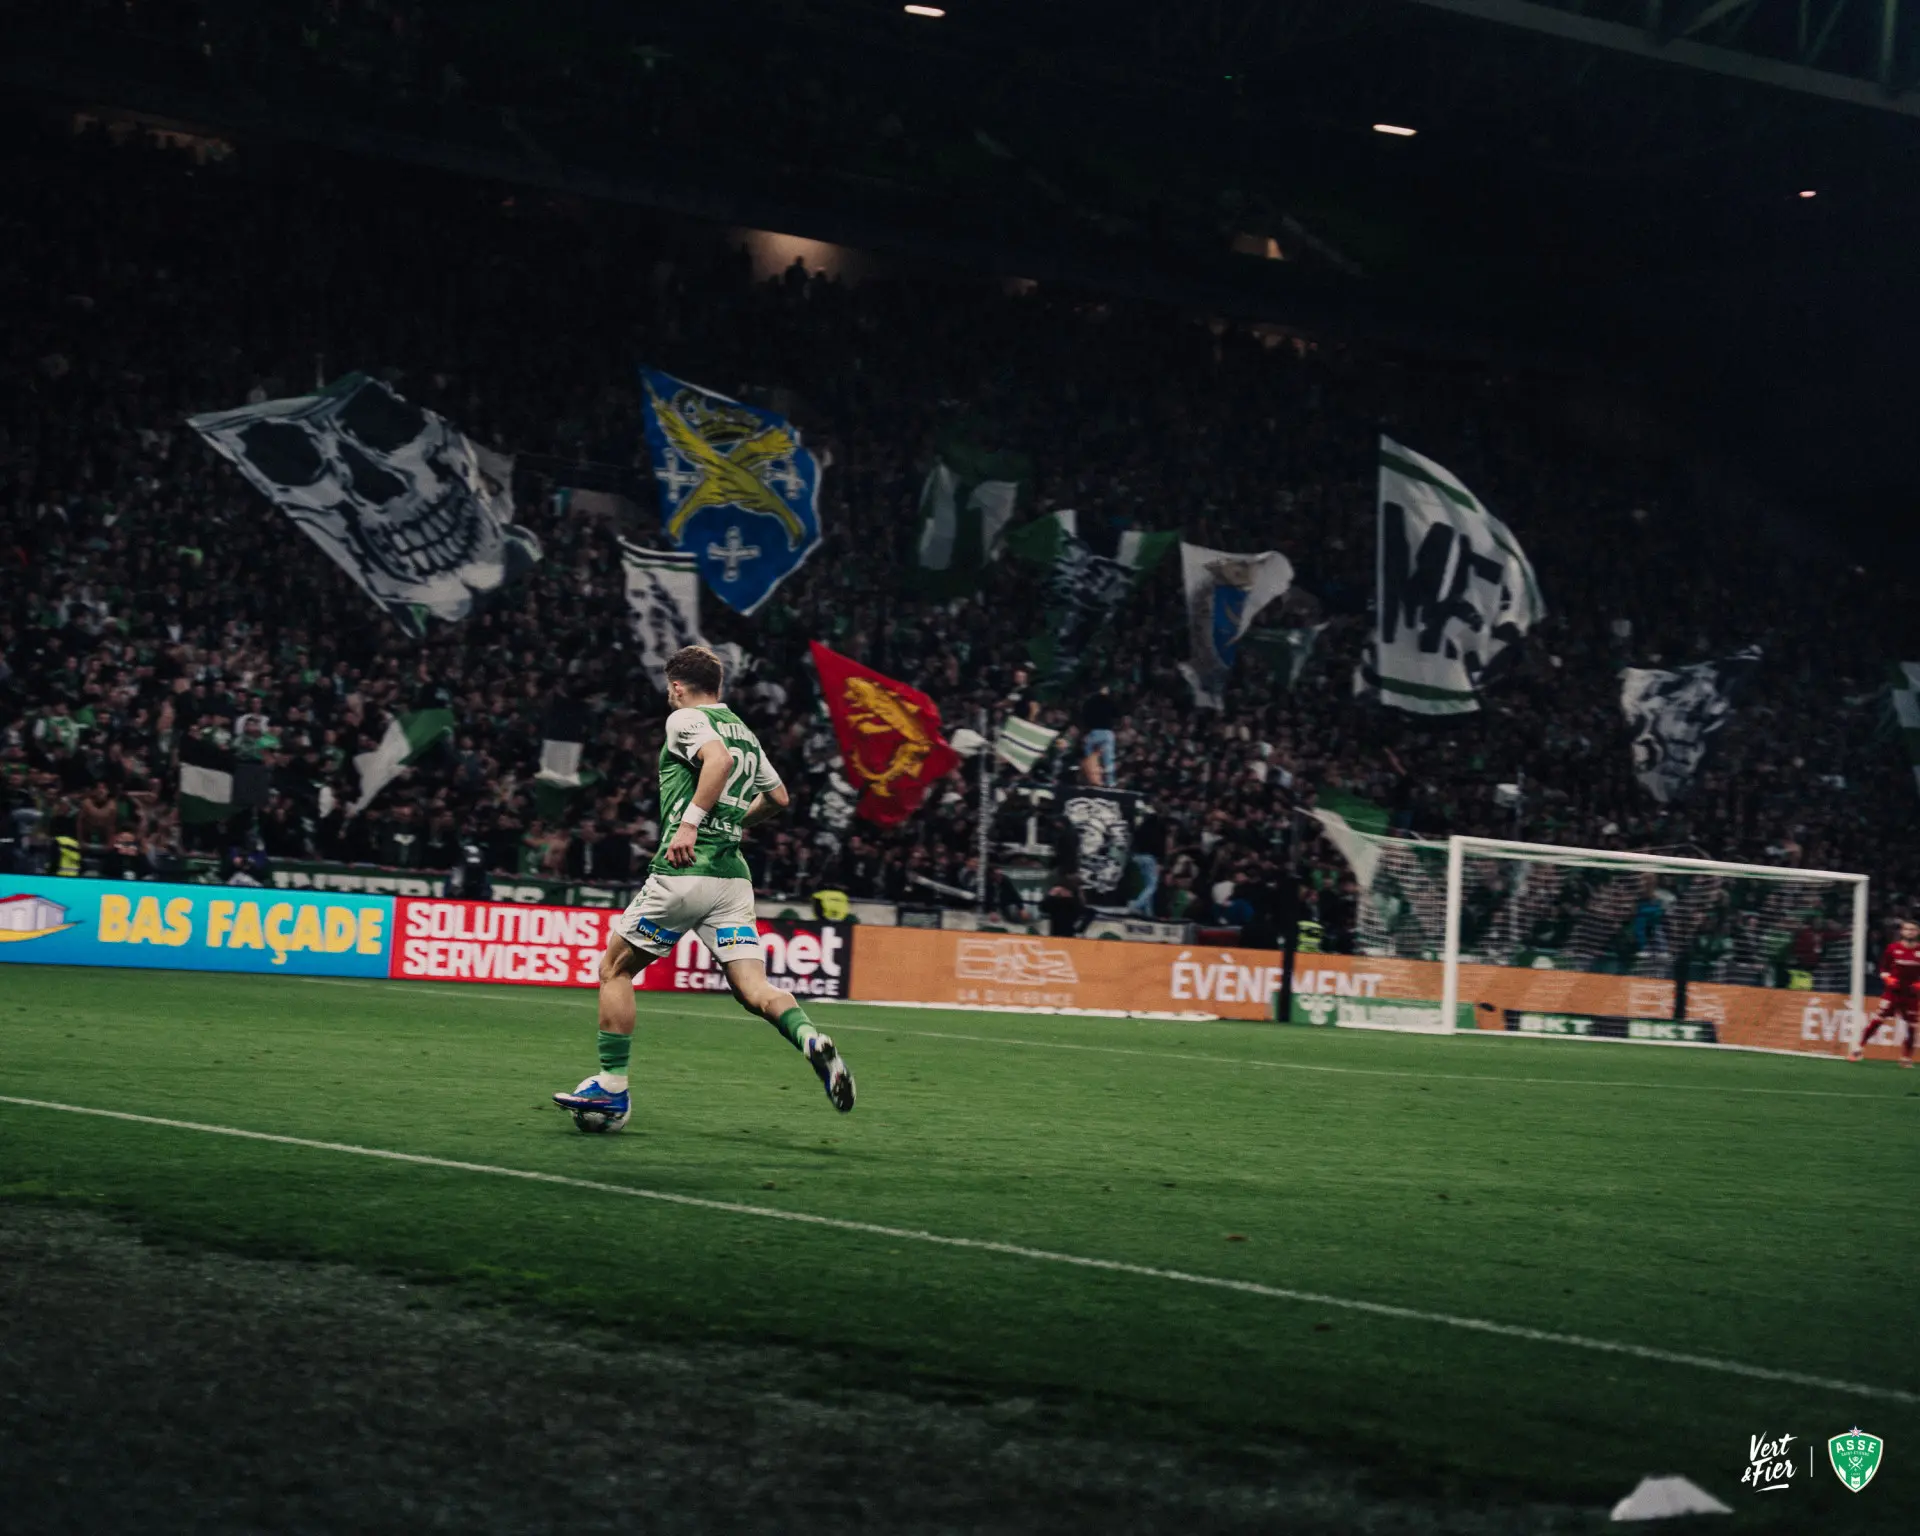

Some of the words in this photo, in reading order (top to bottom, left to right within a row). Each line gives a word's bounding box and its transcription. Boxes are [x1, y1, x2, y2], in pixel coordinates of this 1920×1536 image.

[719, 746, 758, 811] 22
[97, 893, 194, 947] BAS
[206, 899, 384, 965] FAÇADE
[405, 901, 600, 947] SOLUTIONS
[402, 938, 571, 982] SERVICES
[675, 926, 844, 977] mnet
[674, 970, 840, 996] ECHADAGE
[1519, 1014, 1593, 1034] BKT
[1628, 1021, 1701, 1040] BKT
